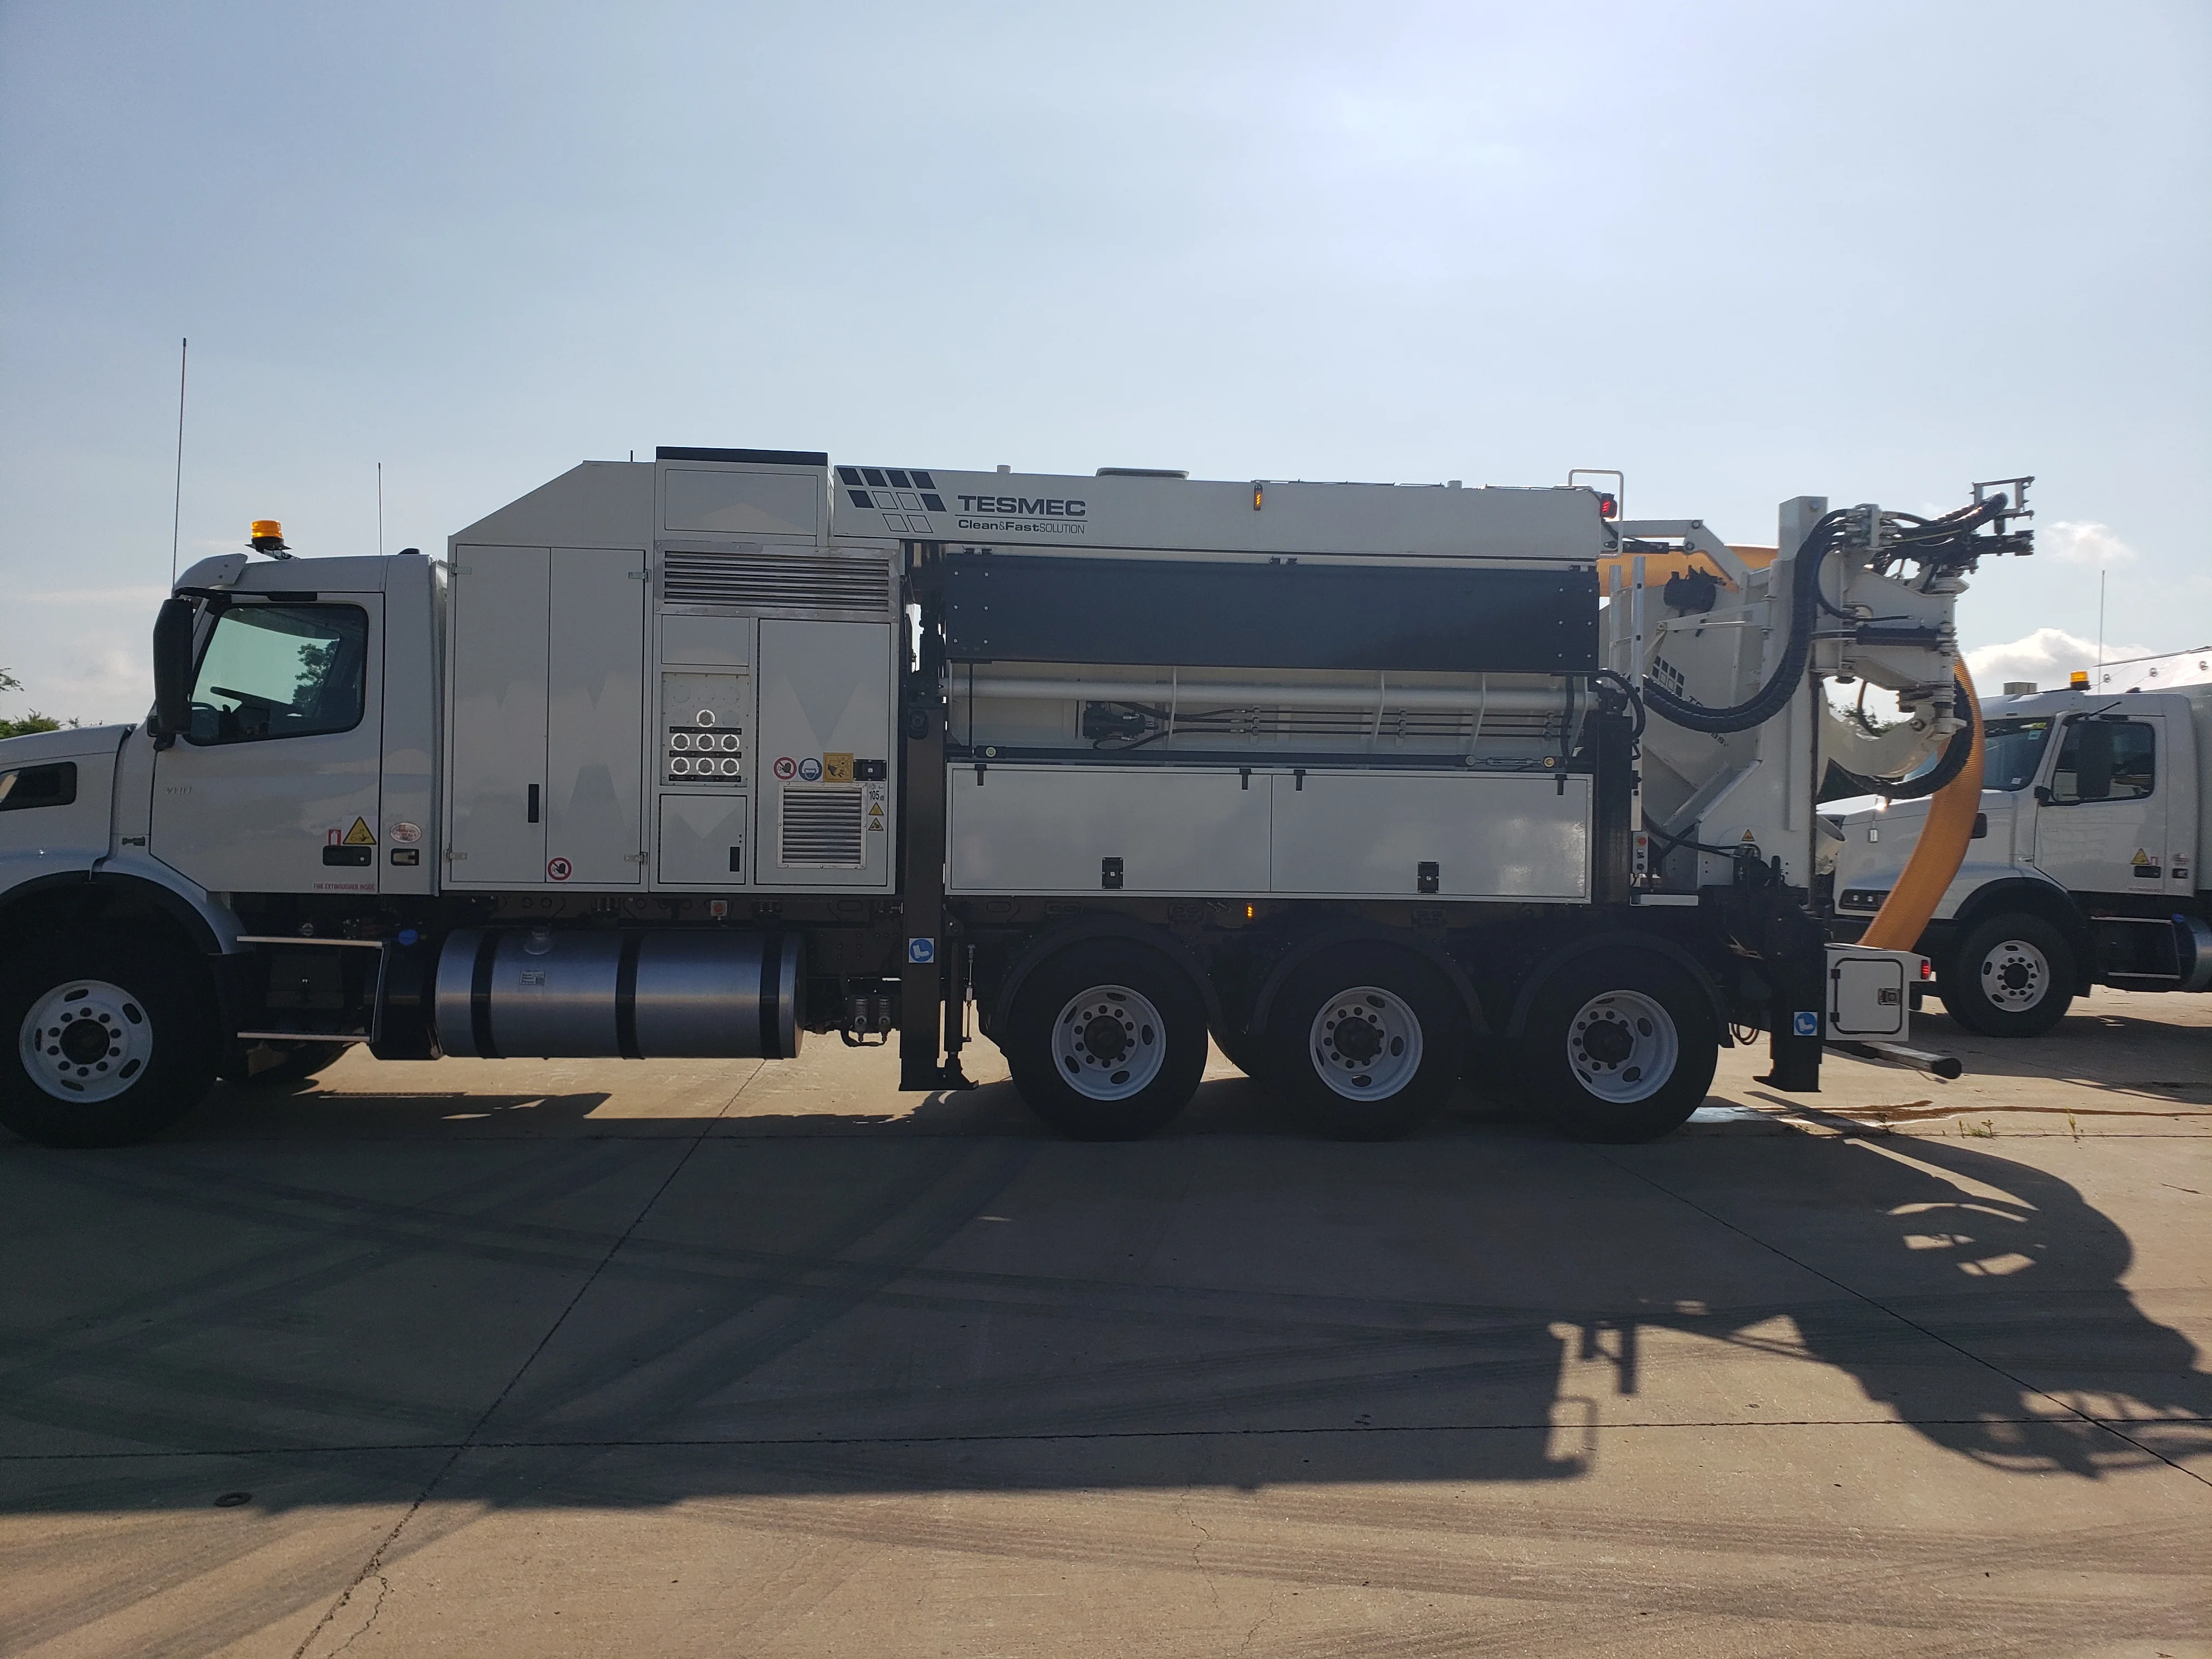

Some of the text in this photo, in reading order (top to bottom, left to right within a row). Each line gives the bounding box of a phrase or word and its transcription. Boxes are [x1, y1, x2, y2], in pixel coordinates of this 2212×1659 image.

[958, 495, 1085, 516] TESMEC
[958, 520, 1085, 534] Clean&FastSOLUTION
[869, 790, 879, 800] 105
